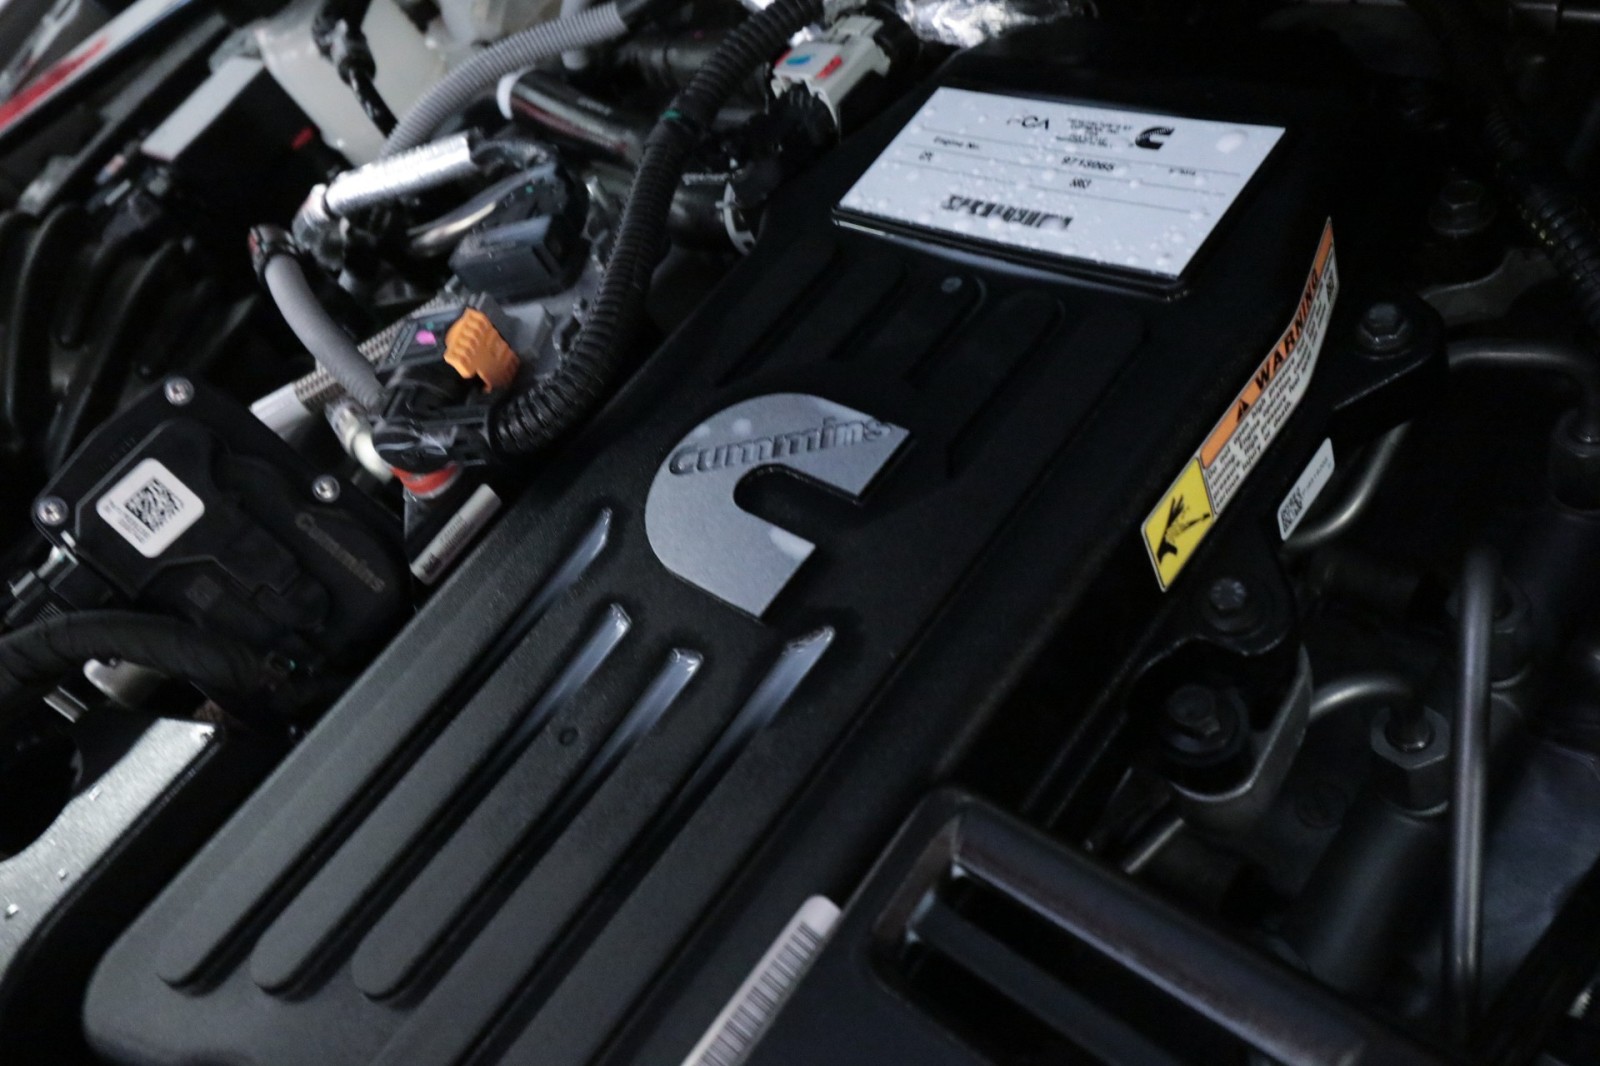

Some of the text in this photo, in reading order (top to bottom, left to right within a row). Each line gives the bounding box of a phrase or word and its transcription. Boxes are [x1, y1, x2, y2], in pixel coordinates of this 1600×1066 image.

[1255, 268, 1318, 391] WARNING
[1219, 446, 1231, 464] not
[1233, 421, 1249, 446] open
[1250, 396, 1266, 420] high
[1266, 355, 1296, 399] pressure
[1239, 418, 1261, 449] Engine
[1261, 373, 1291, 418] operation
[1260, 394, 1287, 435] pressure
[668, 414, 893, 476] Cummins
[1216, 474, 1240, 508] serious
[1241, 443, 1261, 472] injury
